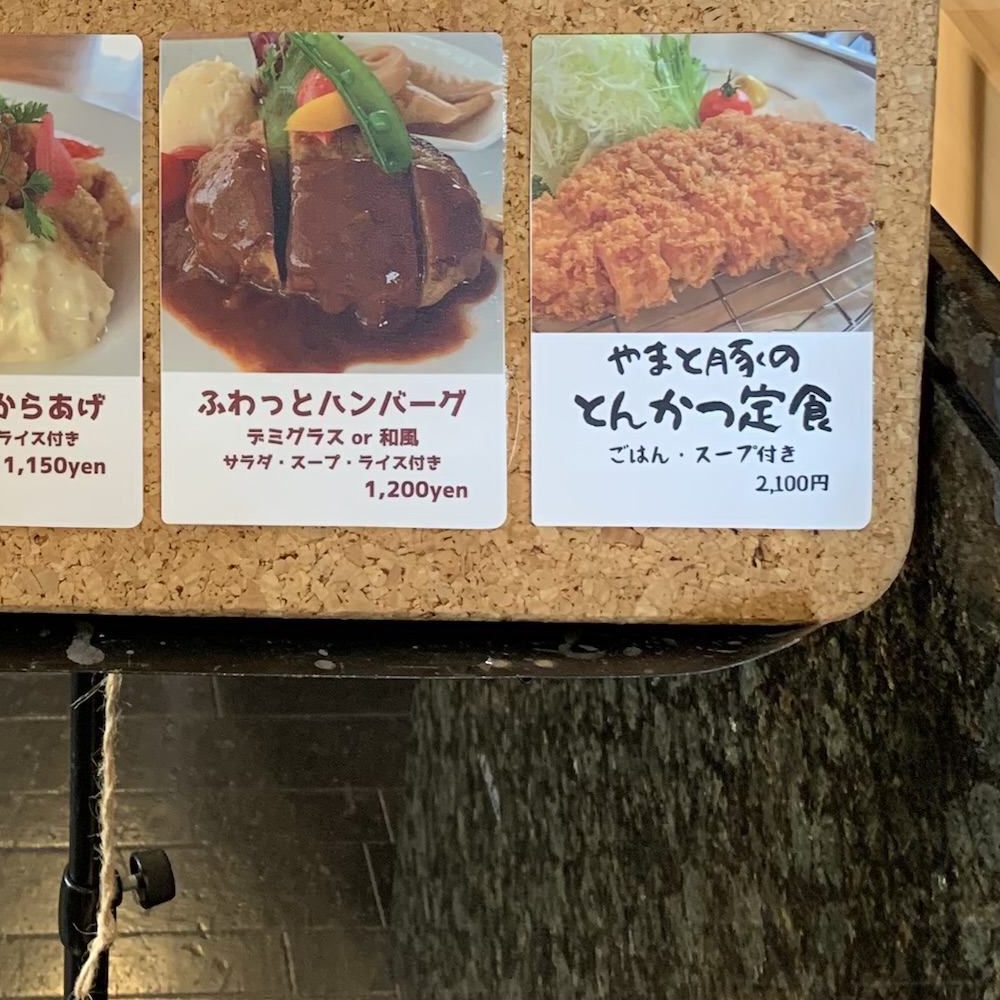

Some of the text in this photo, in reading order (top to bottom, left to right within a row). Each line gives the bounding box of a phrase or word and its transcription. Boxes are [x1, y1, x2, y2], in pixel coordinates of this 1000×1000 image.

[608, 339, 800, 377] やまと豚の
[198, 389, 466, 416] ふわっとハンバーグ
[574, 384, 832, 433] とんかつ定食
[247, 427, 419, 446] デミグラス or 和風
[4, 457, 105, 478] 1,150yen
[366, 481, 467, 502] 1,200yen
[756, 475, 829, 494] 2,100円
